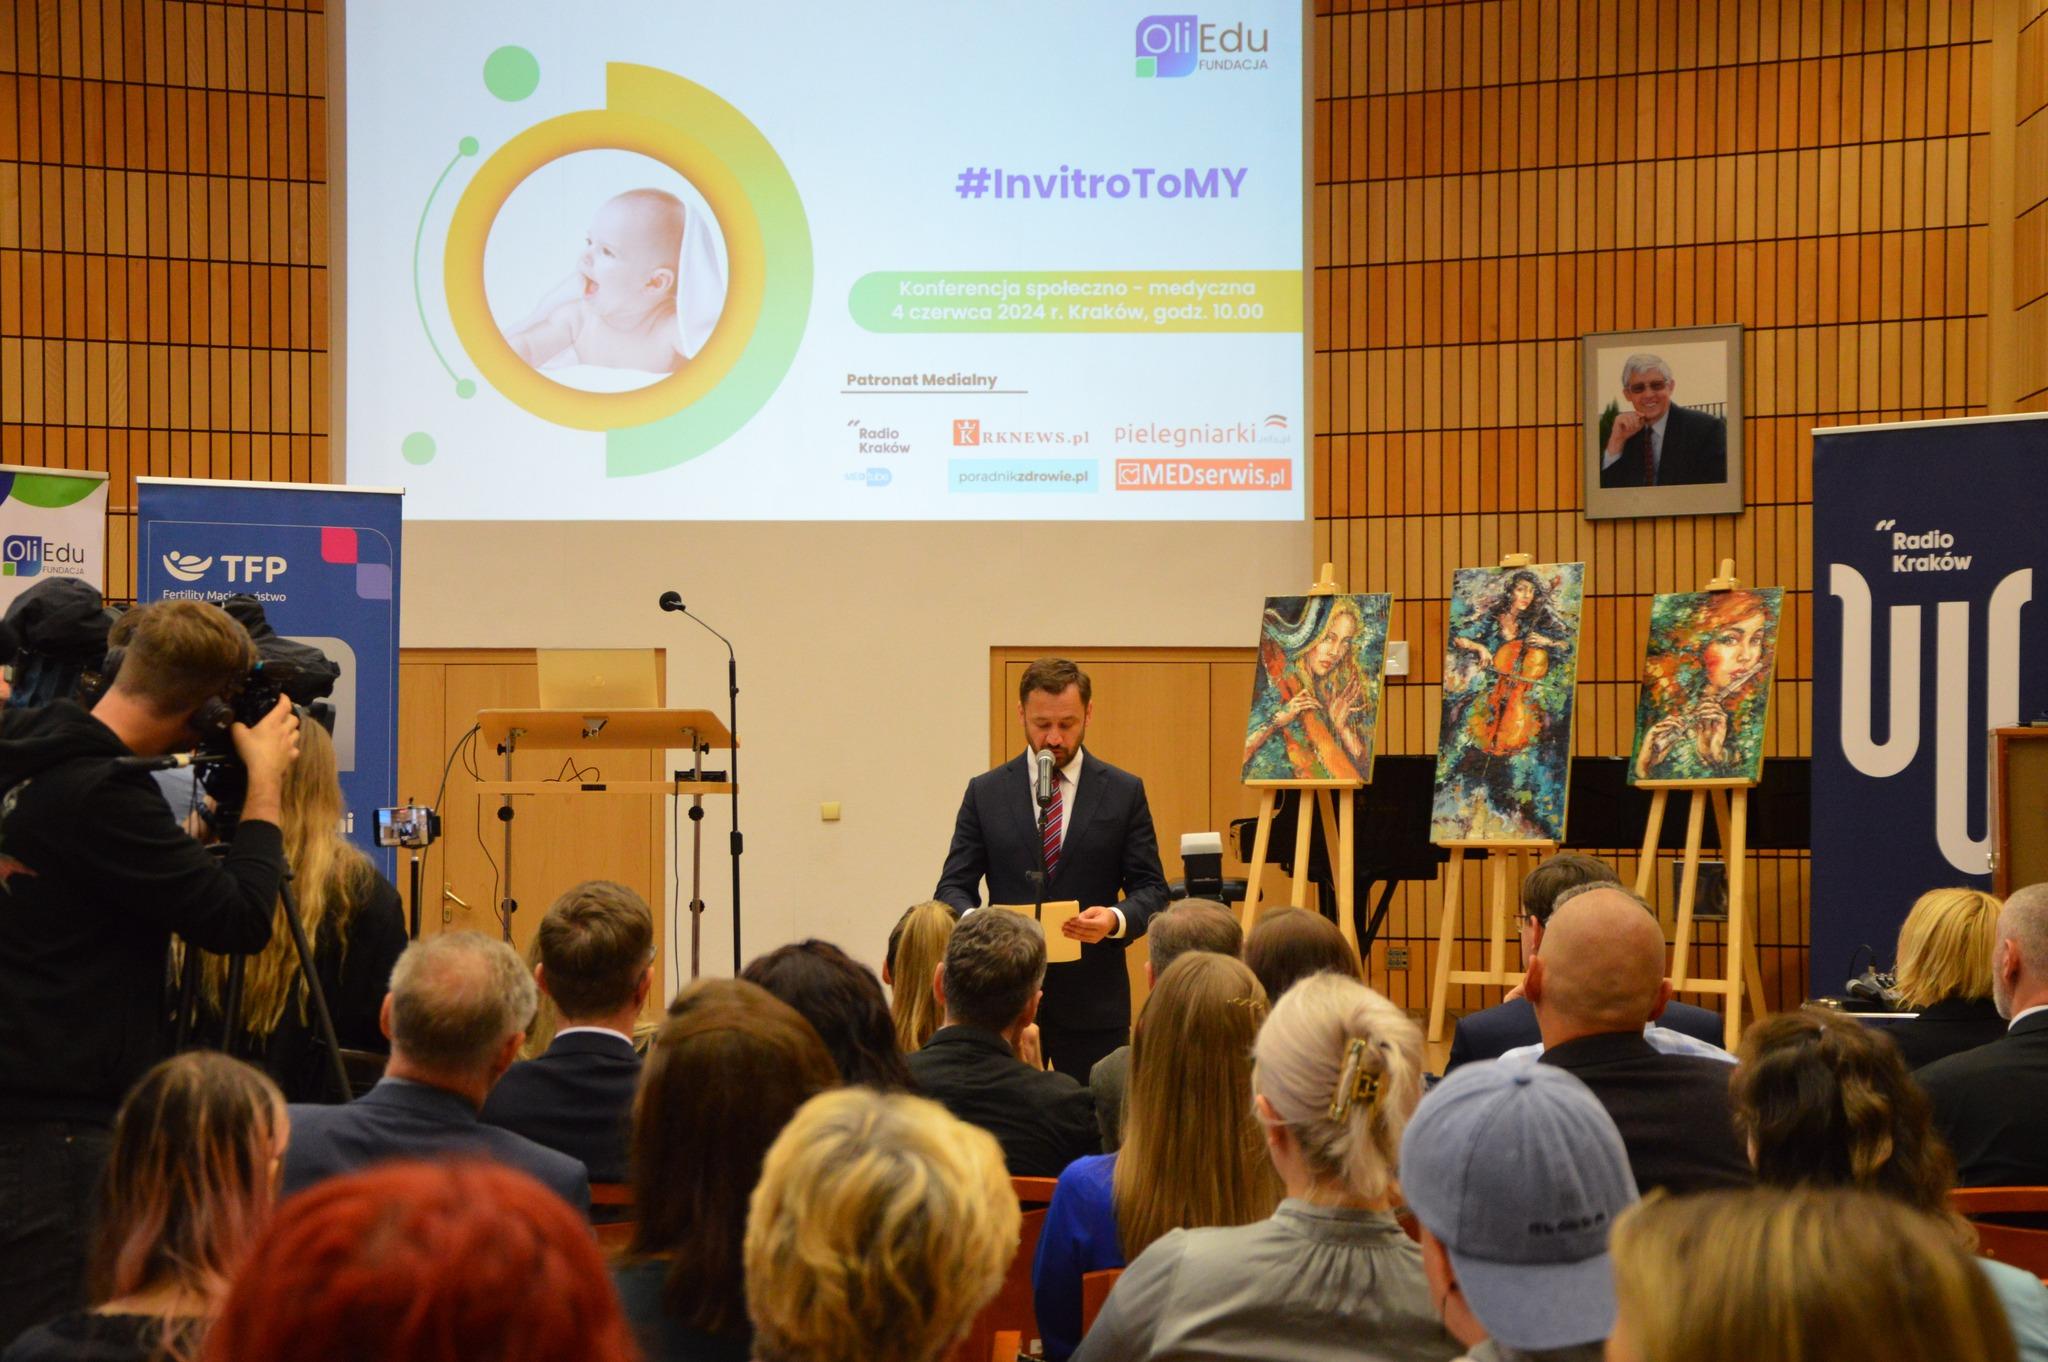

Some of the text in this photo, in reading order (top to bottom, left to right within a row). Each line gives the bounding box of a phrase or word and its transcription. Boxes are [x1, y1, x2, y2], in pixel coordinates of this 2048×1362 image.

[1198, 58, 1269, 71] FUNDACJA
[955, 165, 1248, 199] #InvitroToMY
[899, 279, 1021, 299] Konferencja
[1026, 279, 1128, 299] społeczno
[1149, 278, 1256, 299] medyczna
[892, 302, 1264, 324] 4 czerwca 2024 r. Kraków, godz. 10.00
[846, 372, 998, 390] Patronat Medialny
[858, 428, 900, 440] Radio
[858, 442, 911, 454] Kraków
[959, 470, 1088, 484] poradnikzdrowie.pl
[1143, 462, 1285, 487] MEDserwis.pl
[1893, 530, 1954, 550] Radio
[43, 567, 85, 575] FUNDACJA
[220, 555, 288, 583] TFP
[1892, 552, 1972, 573] Kraków
[163, 589, 204, 601] Fertility
